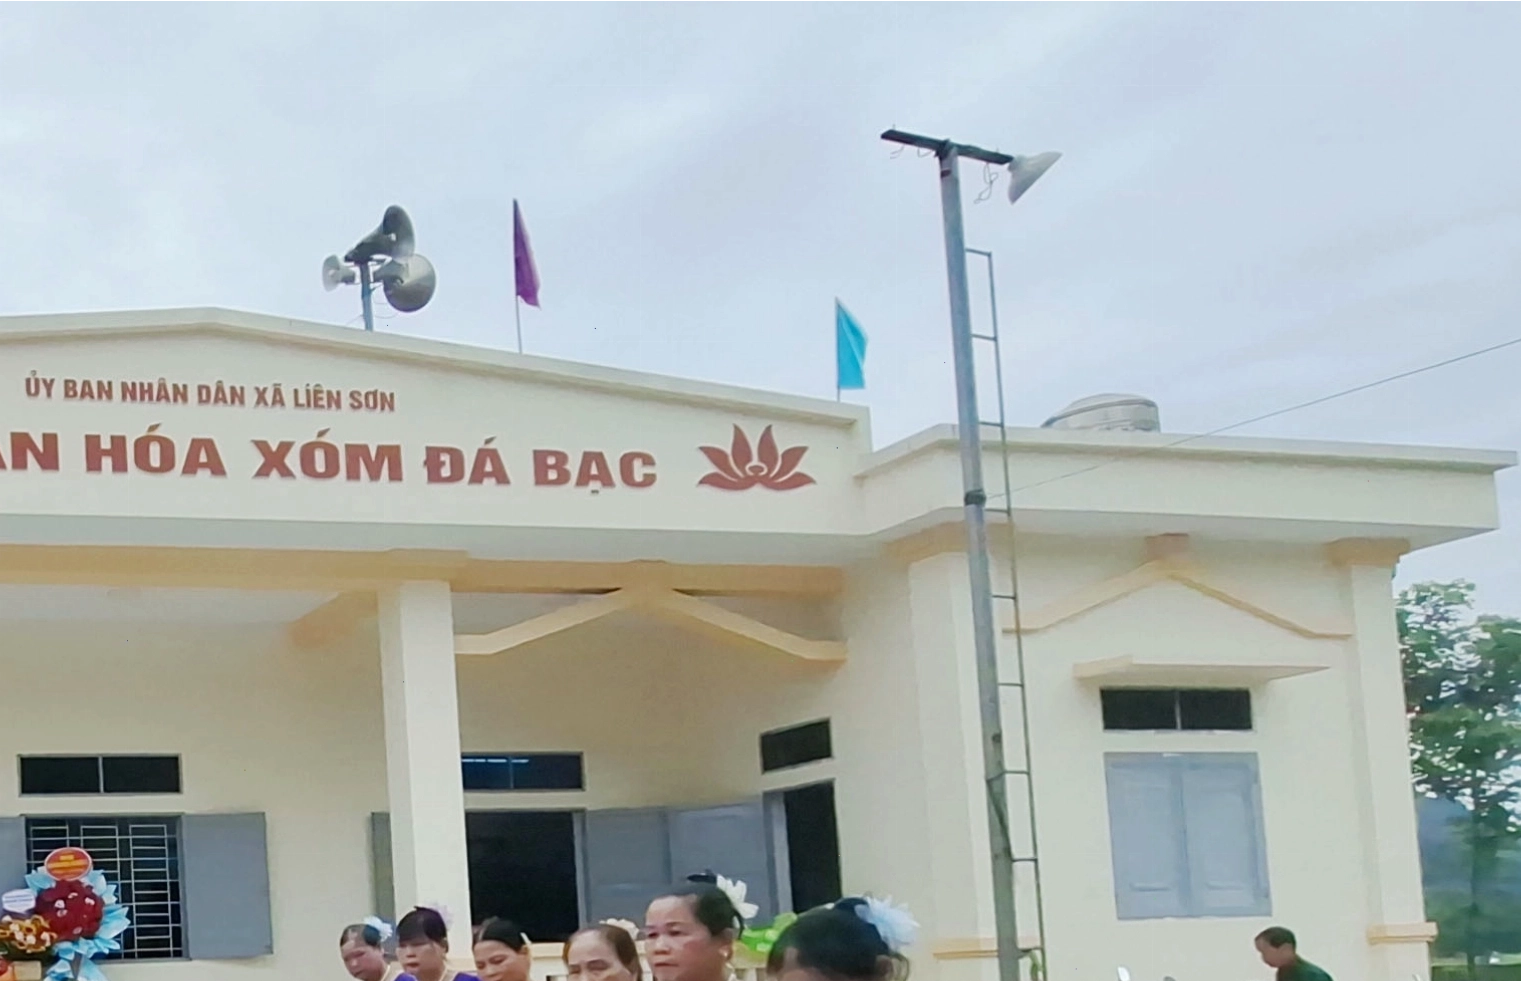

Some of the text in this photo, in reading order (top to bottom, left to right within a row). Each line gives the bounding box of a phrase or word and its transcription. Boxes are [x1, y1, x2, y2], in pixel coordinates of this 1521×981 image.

[25, 369, 55, 399] ỦY
[63, 378, 113, 401] BAN
[121, 377, 189, 404] NHÂN
[197, 379, 246, 406] DÂN
[254, 383, 286, 407] XÃ
[348, 388, 395, 412] SƠN
[84, 422, 227, 477] HÓA
[250, 427, 404, 482] XÓM
[423, 435, 511, 486] ĐÁ
[532, 449, 657, 496] BẠC
